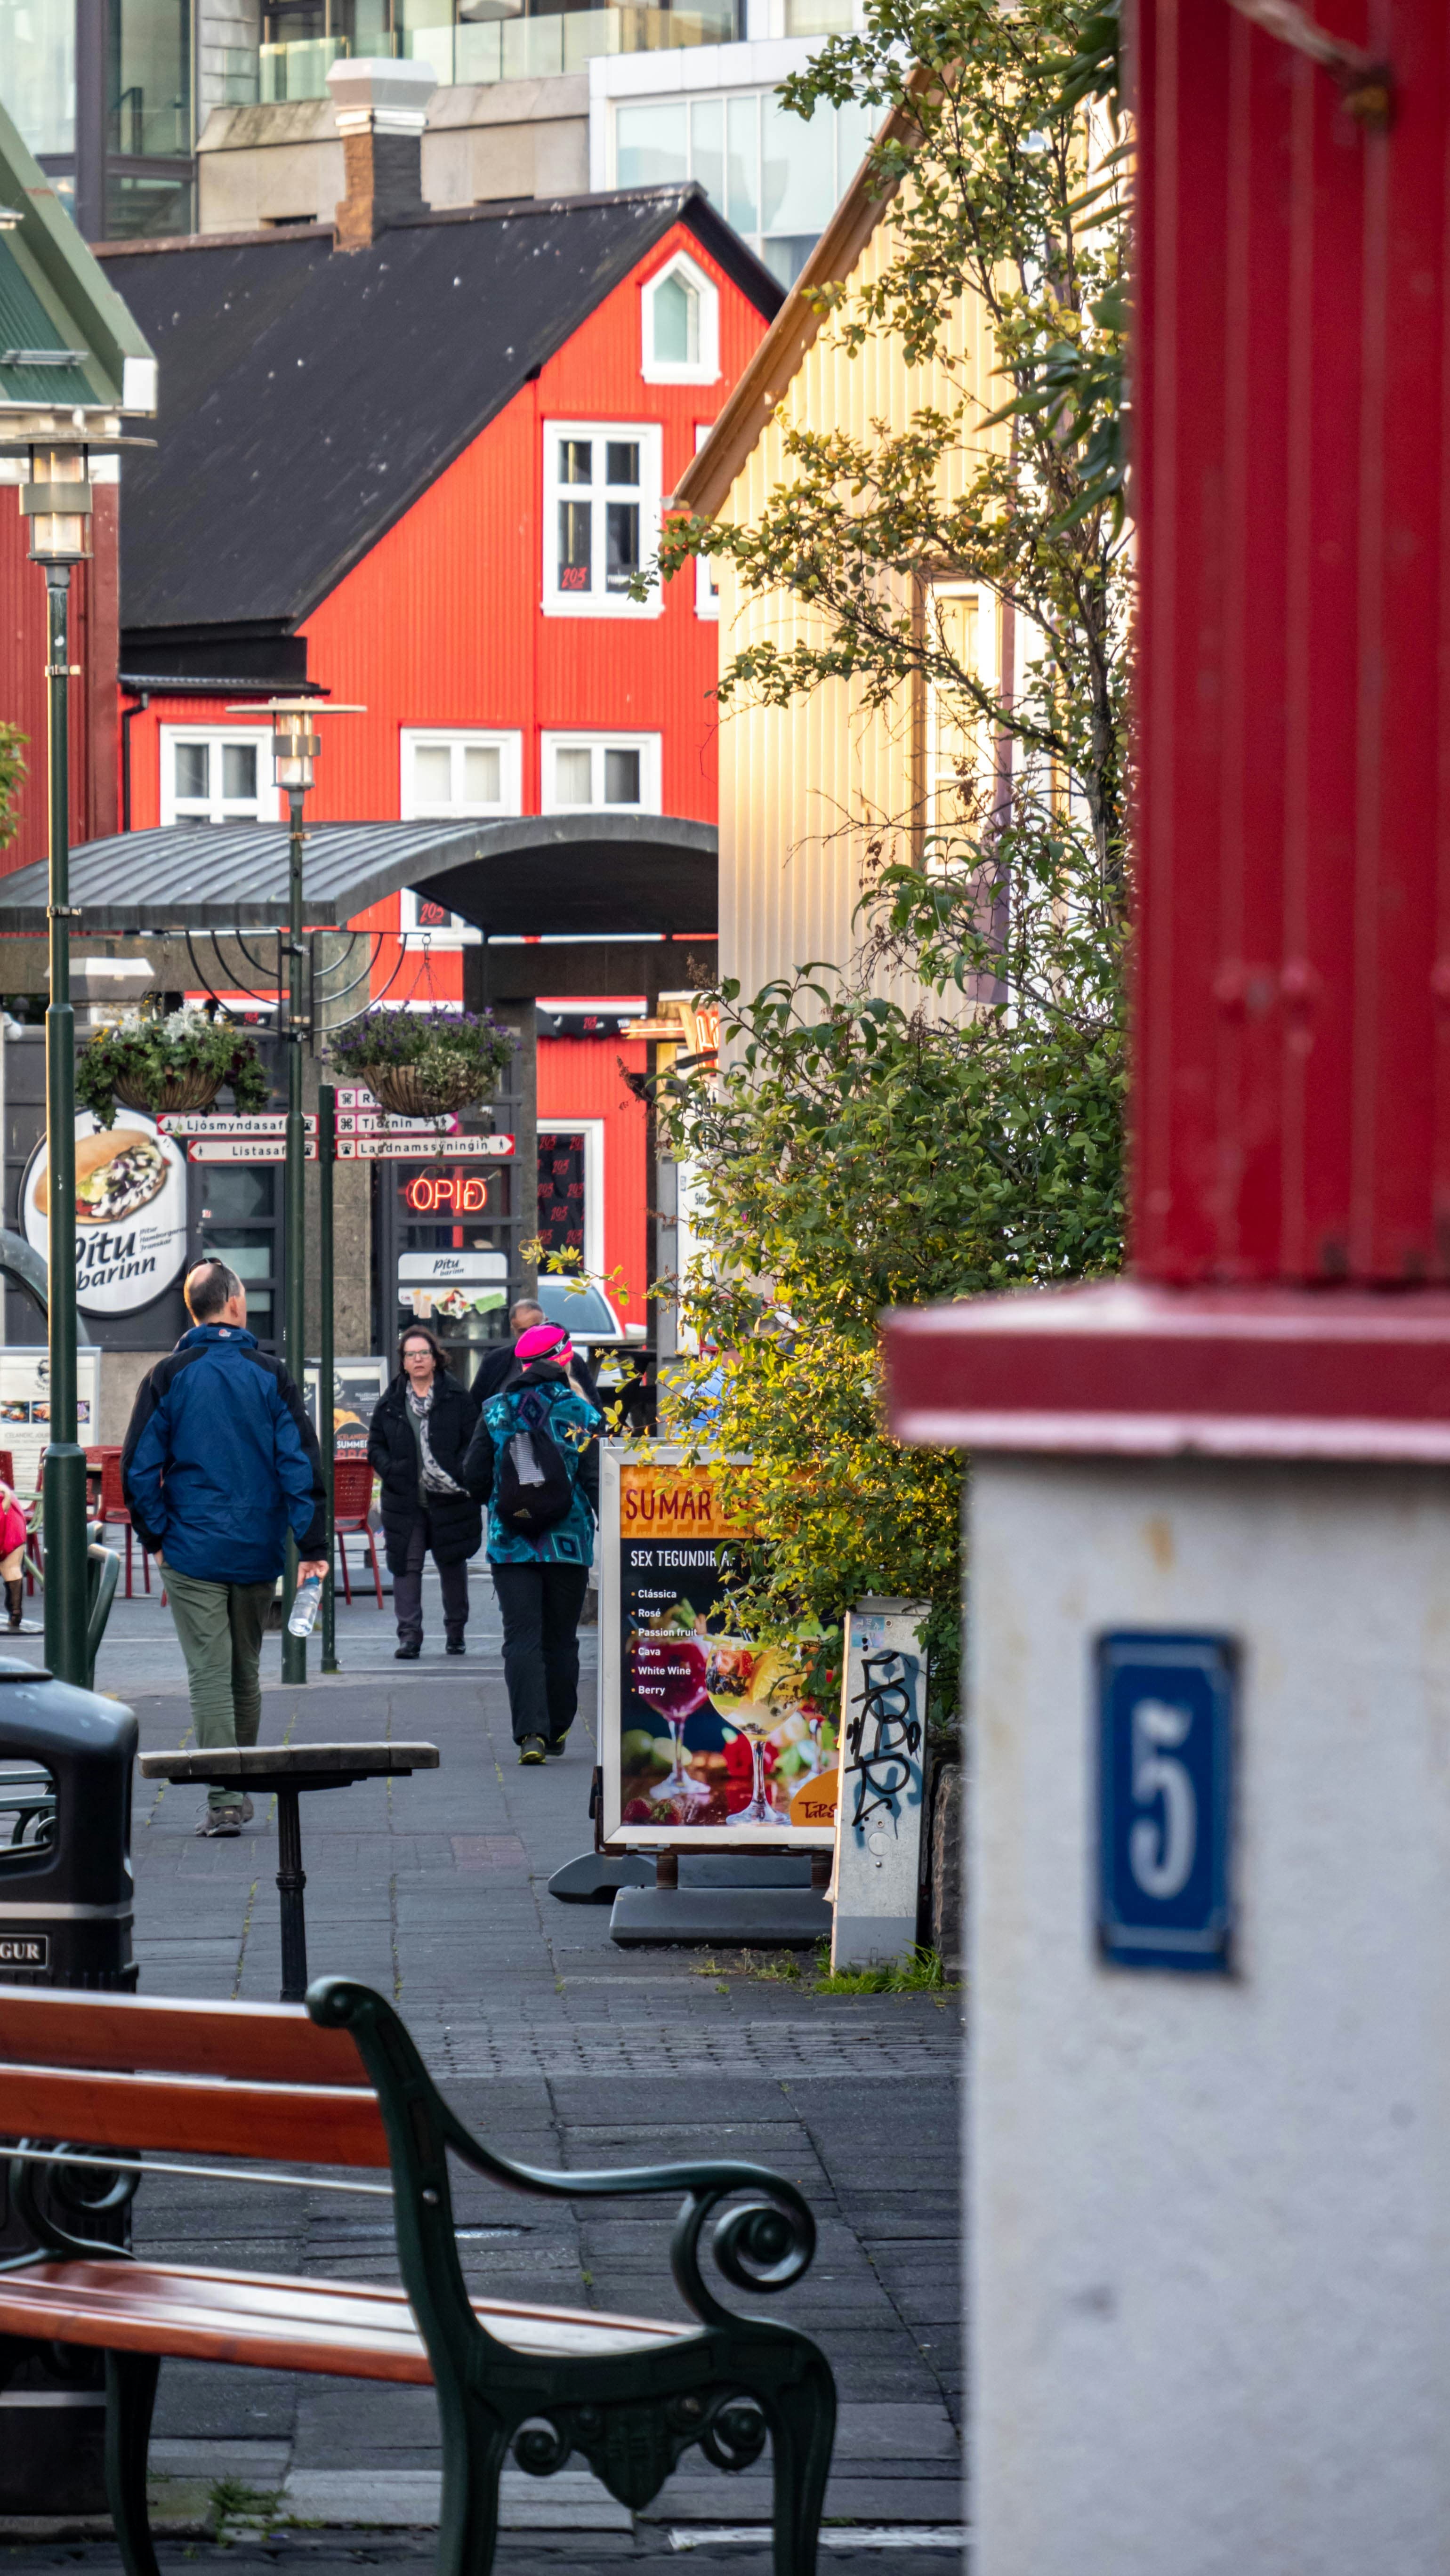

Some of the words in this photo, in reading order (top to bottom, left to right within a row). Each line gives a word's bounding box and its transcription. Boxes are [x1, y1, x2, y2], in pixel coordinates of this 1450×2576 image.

[187, 1120, 283, 1132] Ljósmyndasaf
[232, 1145, 286, 1156] Listasaf
[76, 1256, 156, 1291] barinn
[625, 1489, 712, 1520] SUMAR
[630, 1550, 652, 1567] SEX
[656, 1550, 717, 1567] TEGUNDIR
[638, 1589, 677, 1598] Clássica
[638, 1608, 661, 1617] Rosé
[638, 1628, 675, 1636] Passion
[677, 1628, 698, 1636] fruit
[638, 1648, 661, 1656] Cava
[638, 1666, 665, 1675] White
[667, 1666, 691, 1675] Wine
[638, 1686, 665, 1696] Berry
[1130, 1698, 1198, 1900] 5
